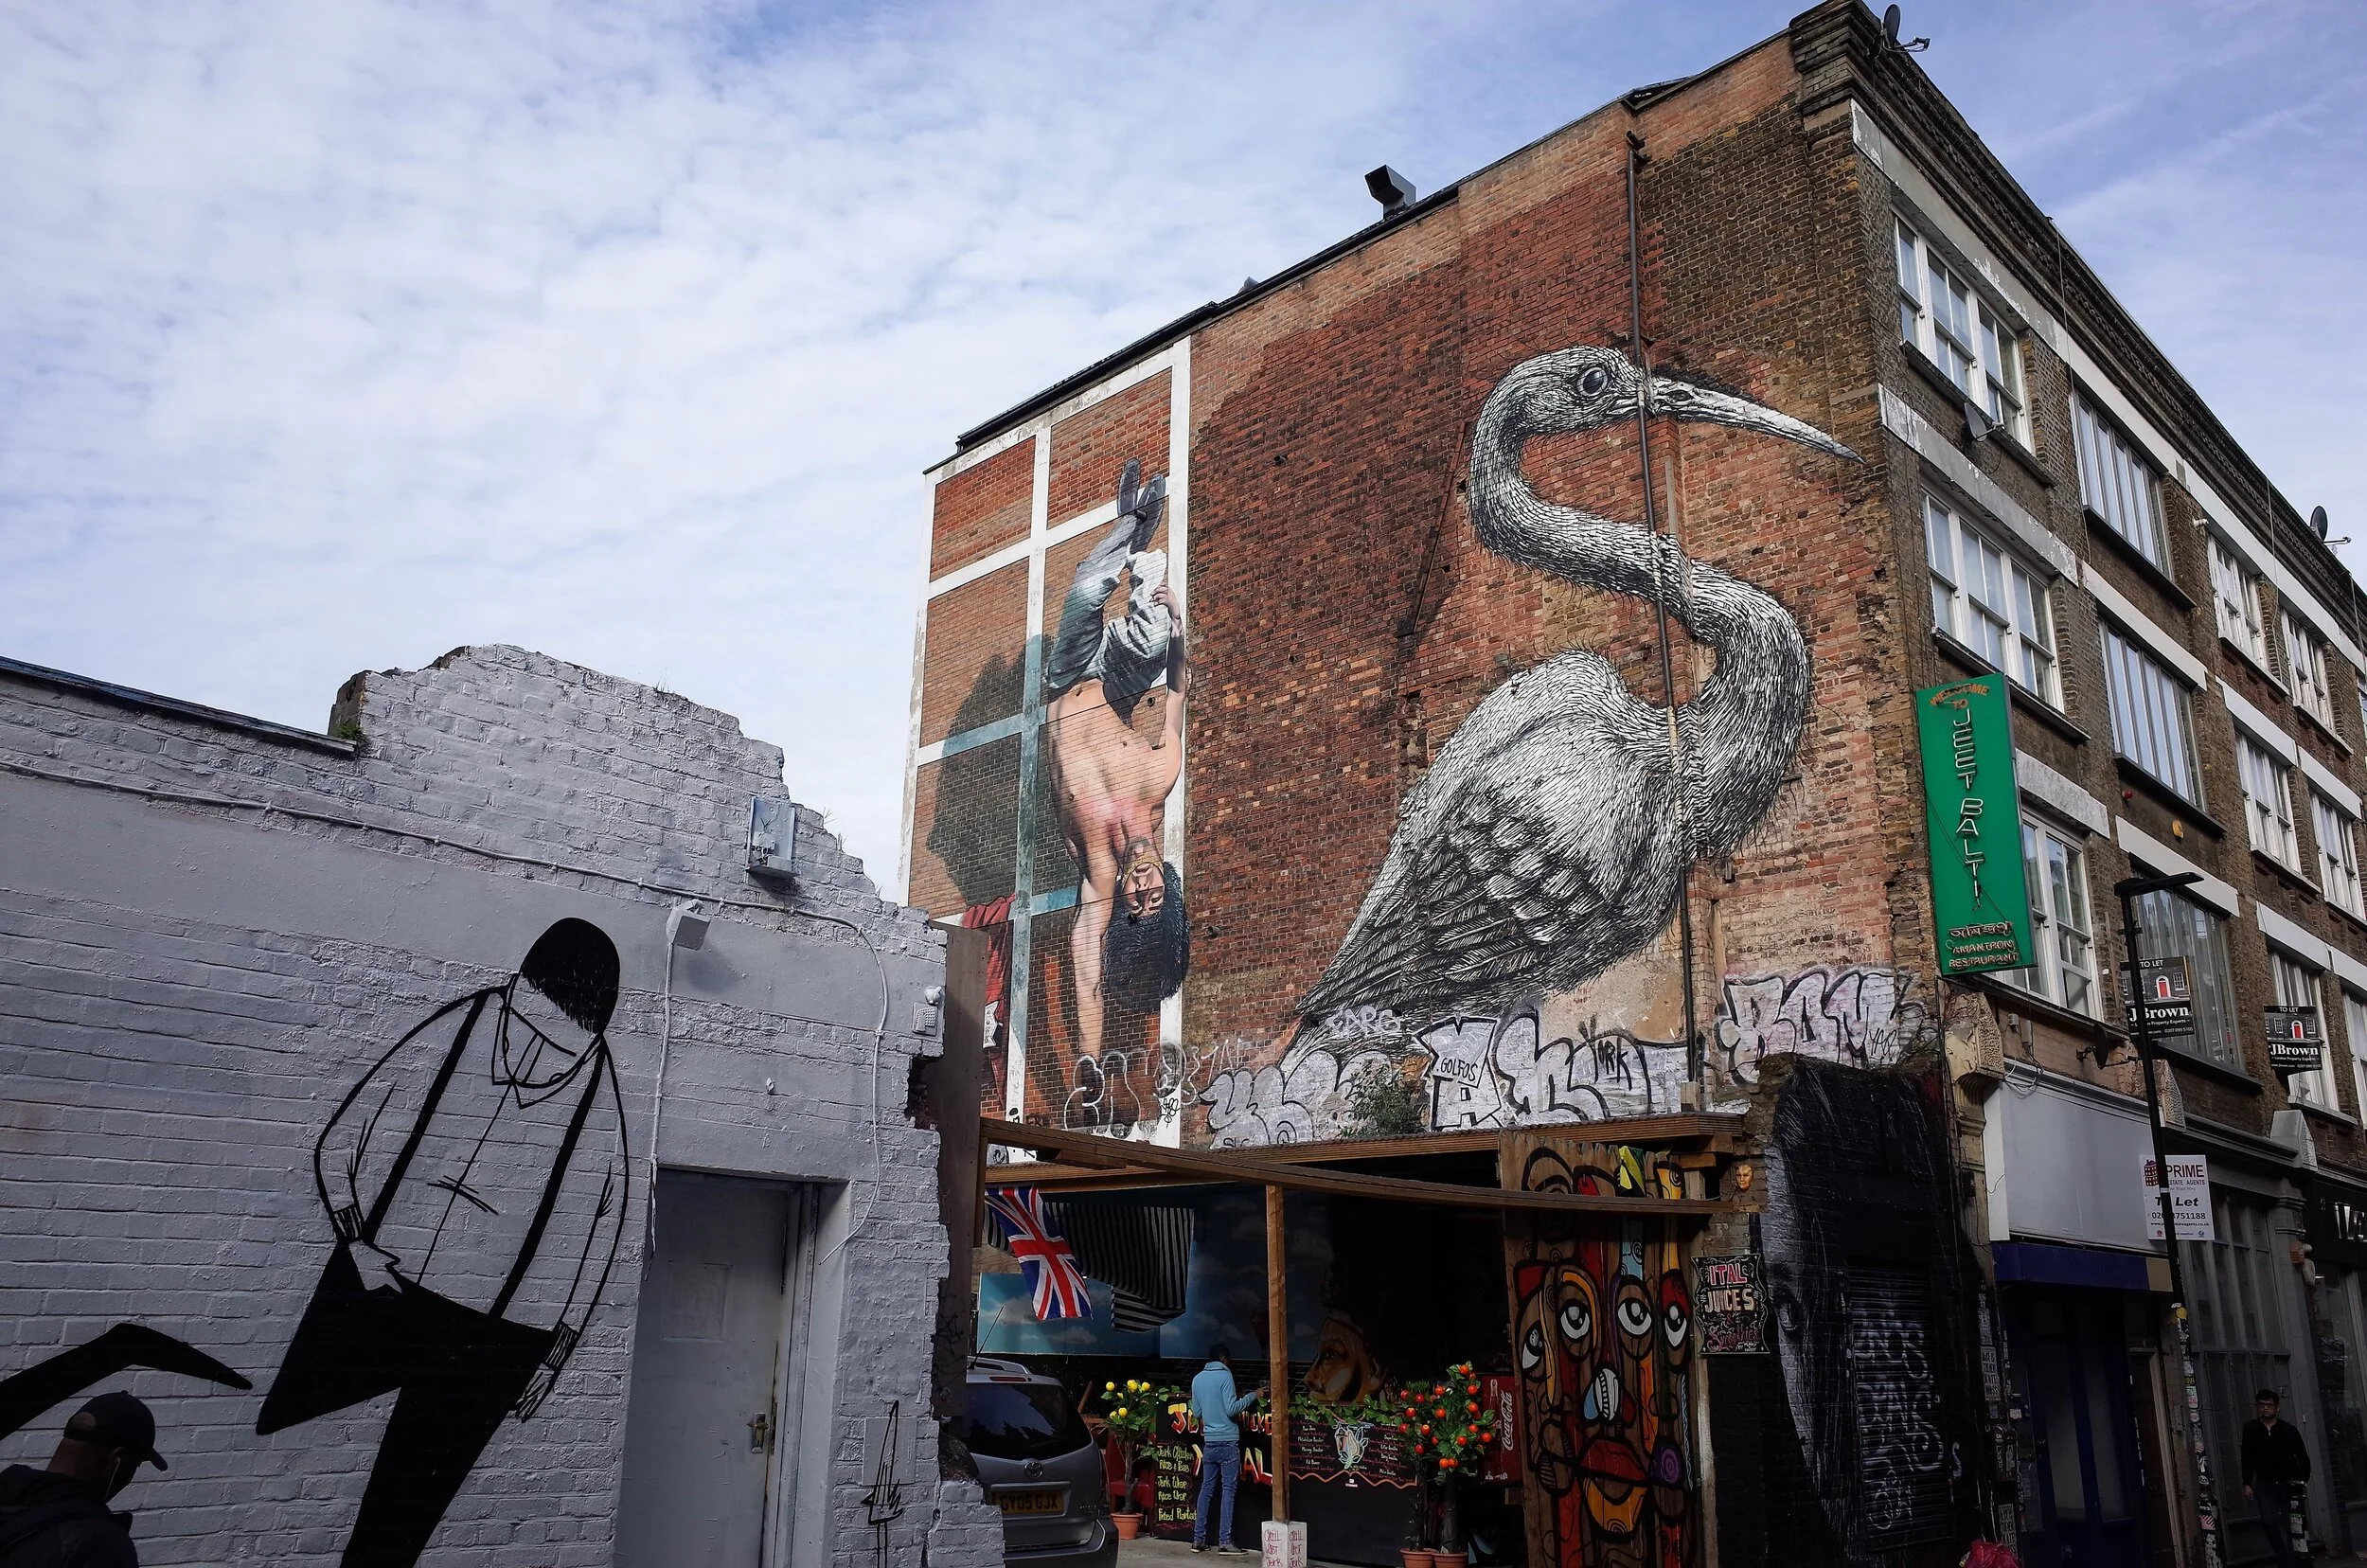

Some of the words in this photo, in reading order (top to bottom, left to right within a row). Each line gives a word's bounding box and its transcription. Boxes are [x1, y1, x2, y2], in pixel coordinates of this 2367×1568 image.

[1949, 953, 2018, 968] RESTAURANT
[2270, 1043, 2319, 1056] JBrown
[2175, 1196, 2199, 1206] Let
[1709, 1263, 1747, 1285] ITAL
[1704, 1289, 1754, 1312] JUICES
